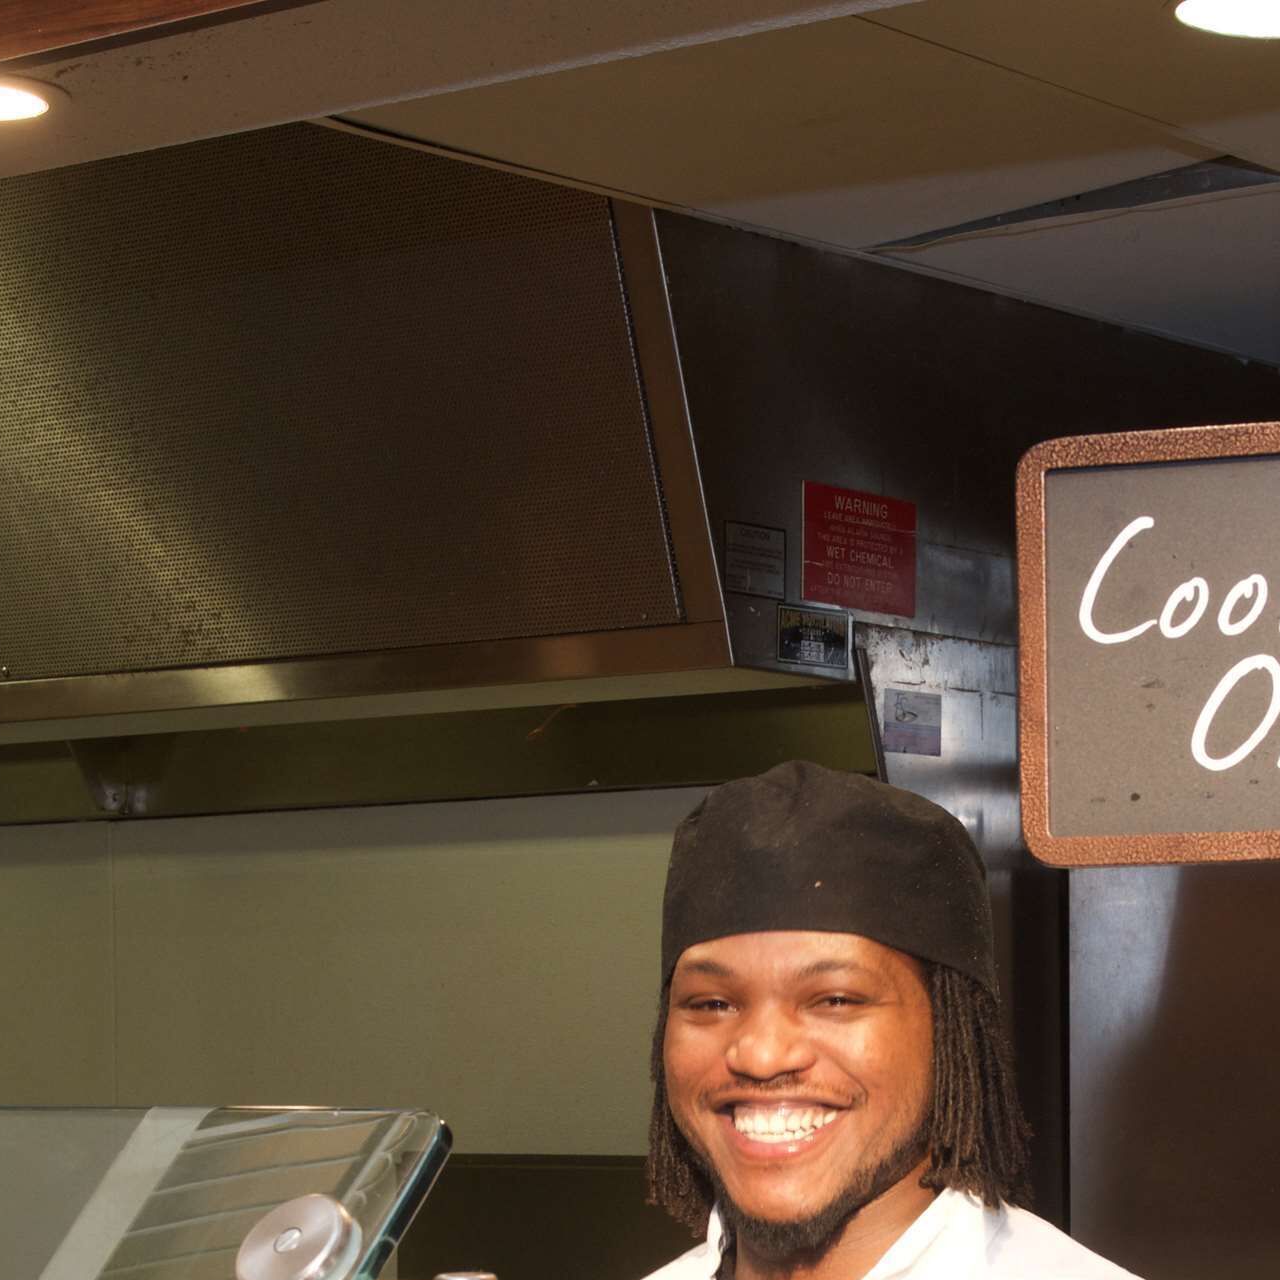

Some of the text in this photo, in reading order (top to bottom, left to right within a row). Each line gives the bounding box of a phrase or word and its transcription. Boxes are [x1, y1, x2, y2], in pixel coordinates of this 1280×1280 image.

[834, 495, 888, 519] WARNING
[826, 545, 894, 569] WET CHEMICAL
[827, 572, 894, 593] DO NOT ENTER
